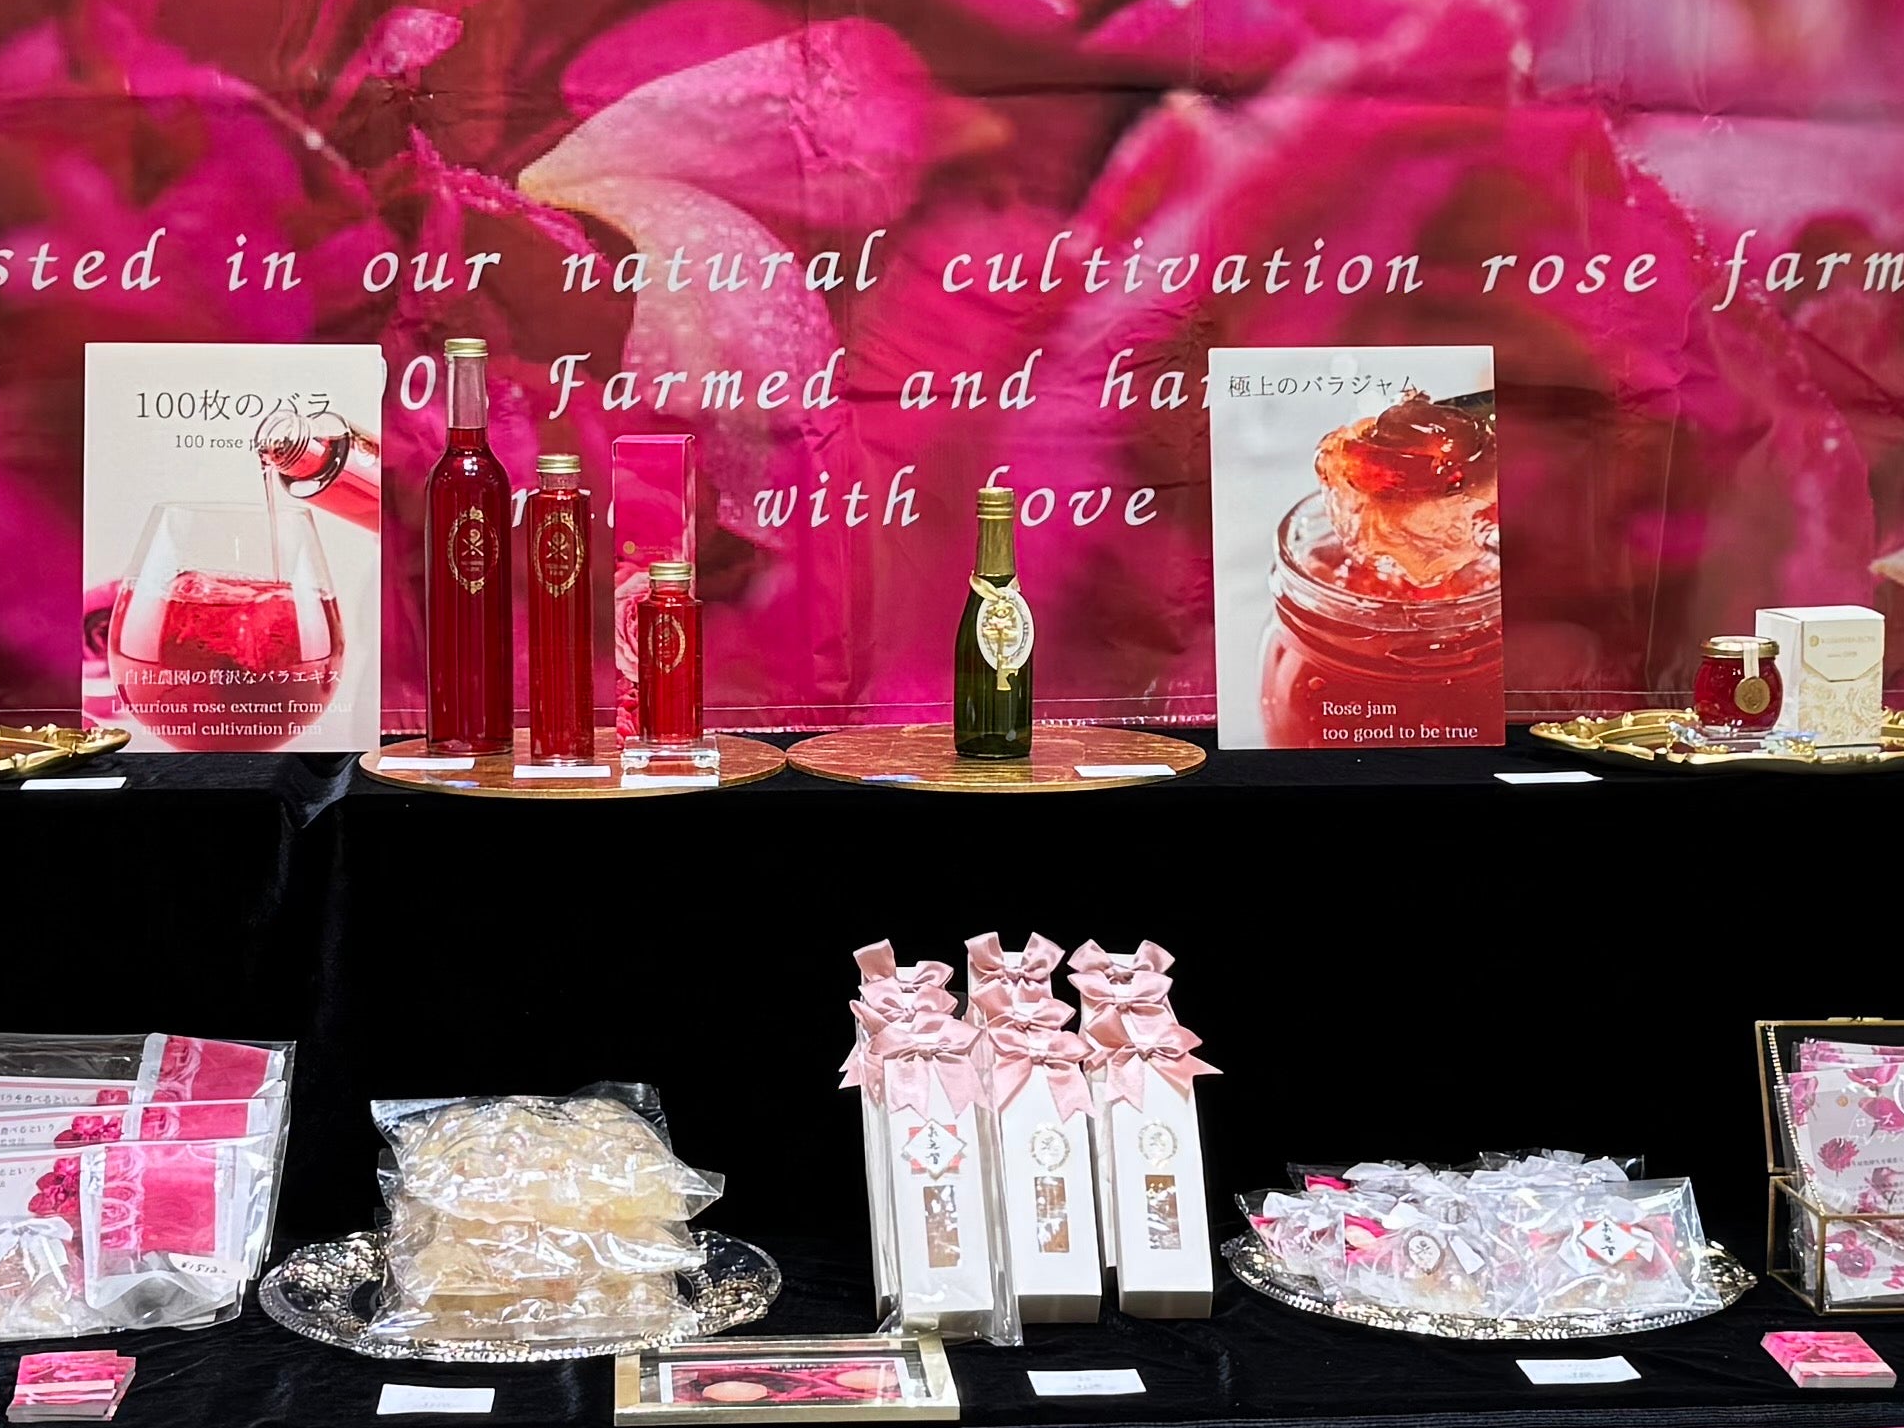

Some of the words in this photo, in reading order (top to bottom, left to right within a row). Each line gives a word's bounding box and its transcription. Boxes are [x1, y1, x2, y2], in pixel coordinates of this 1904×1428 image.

[226, 232, 305, 291] in
[361, 246, 503, 294] our
[559, 227, 886, 294] natural
[940, 228, 1426, 296] cultivation
[1481, 246, 1662, 294] rose
[548, 351, 846, 420] Farmed
[899, 348, 1039, 412] and
[1228, 374, 1418, 399] 極上のバラジャム
[135, 389, 334, 423] 100枚のバラ
[174, 435, 205, 450] 100
[210, 437, 244, 450] rose
[753, 464, 921, 528] with
[124, 668, 343, 686] 自社農園の贅沢なバラエキス
[111, 698, 189, 715] Luxurious
[193, 700, 227, 715] rose
[230, 699, 284, 715] extract
[287, 698, 324, 715] from
[327, 701, 353, 715] our
[1322, 700, 1362, 717] Rose
[1365, 700, 1398, 720] jam
[142, 720, 197, 737] natural
[201, 719, 283, 737] cultivation
[286, 720, 323, 737] farm
[1322, 725, 1350, 741] too
[1353, 723, 1395, 744] good
[1399, 725, 1416, 740] to
[1420, 723, 1441, 740] be
[1444, 725, 1479, 740] true
